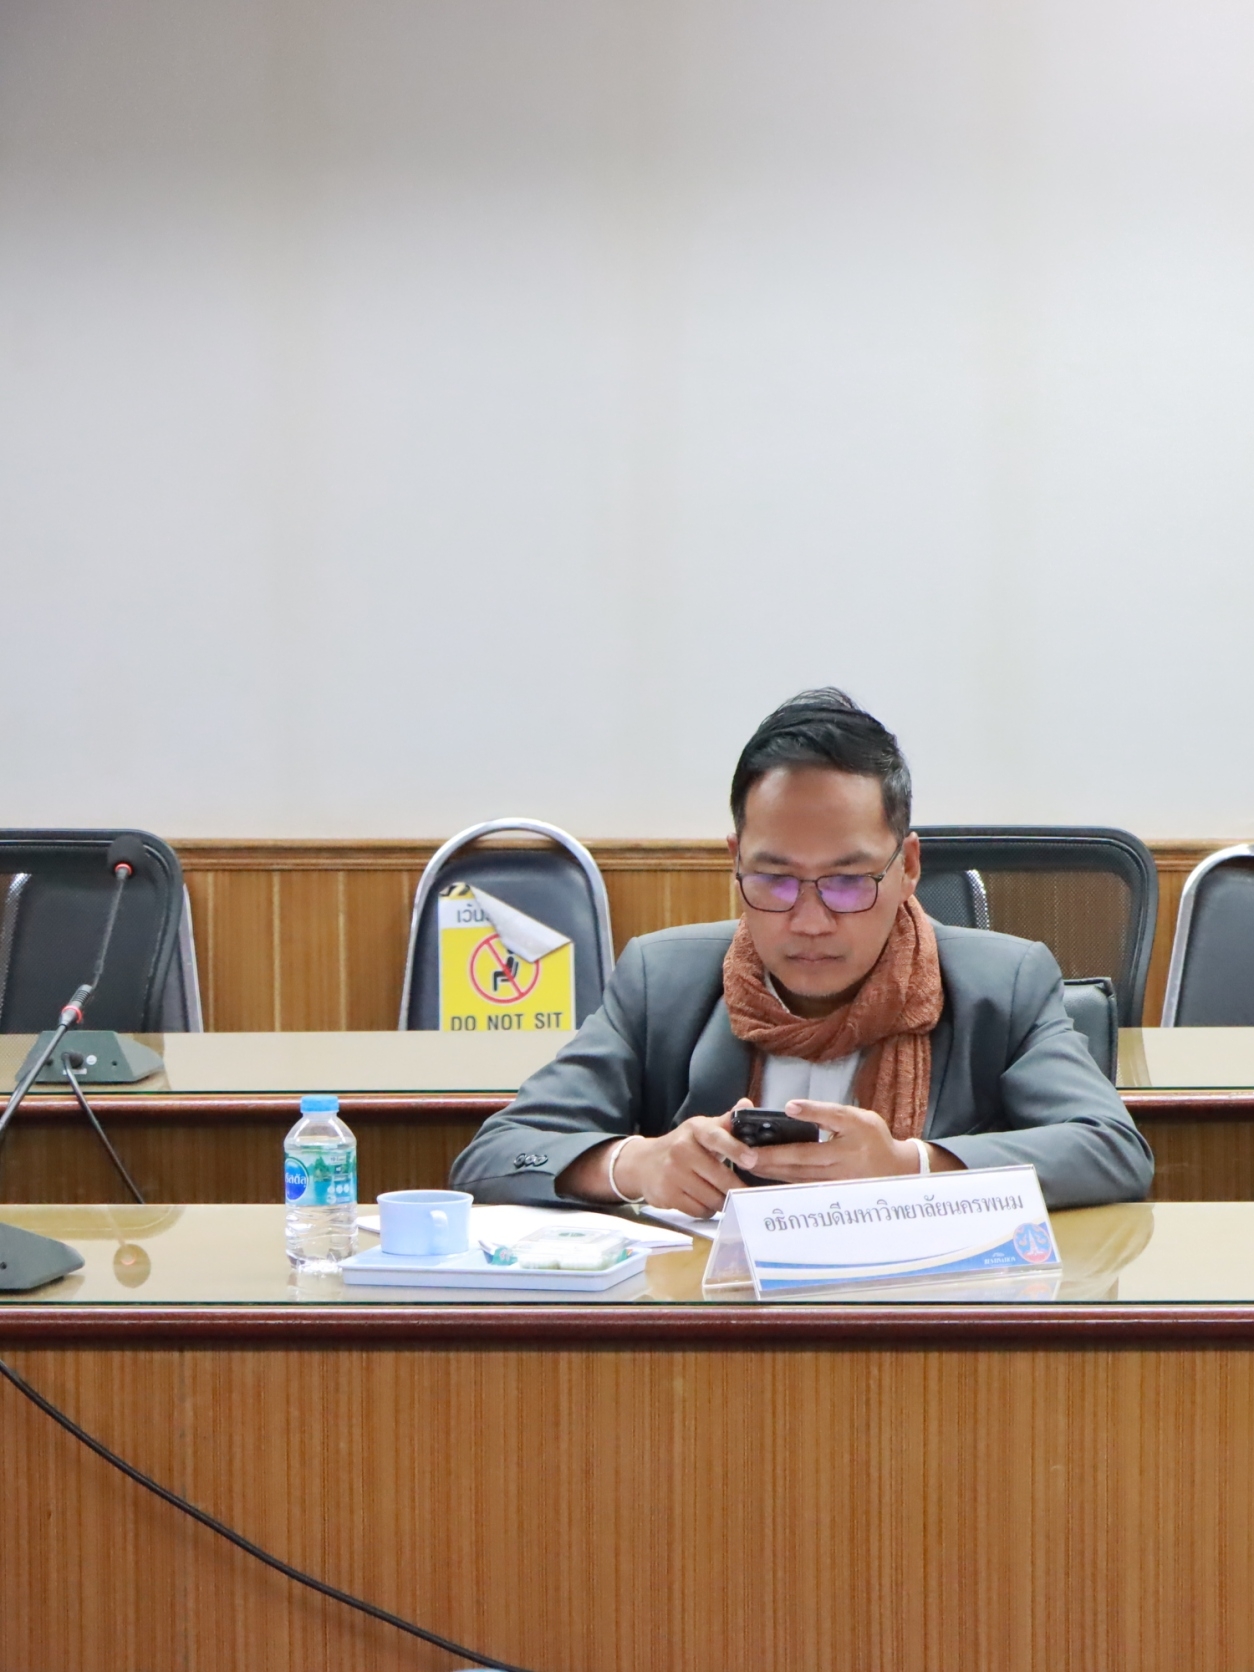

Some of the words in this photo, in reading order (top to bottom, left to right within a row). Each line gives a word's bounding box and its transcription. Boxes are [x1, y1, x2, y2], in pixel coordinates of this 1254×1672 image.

[456, 903, 491, 923] เว้น
[450, 1015, 476, 1031] DO
[487, 1013, 524, 1031] NOT
[534, 1012, 563, 1030] SIT
[763, 1194, 1025, 1233] อธิการบดีมหาวิทยาลัยนครพนม
